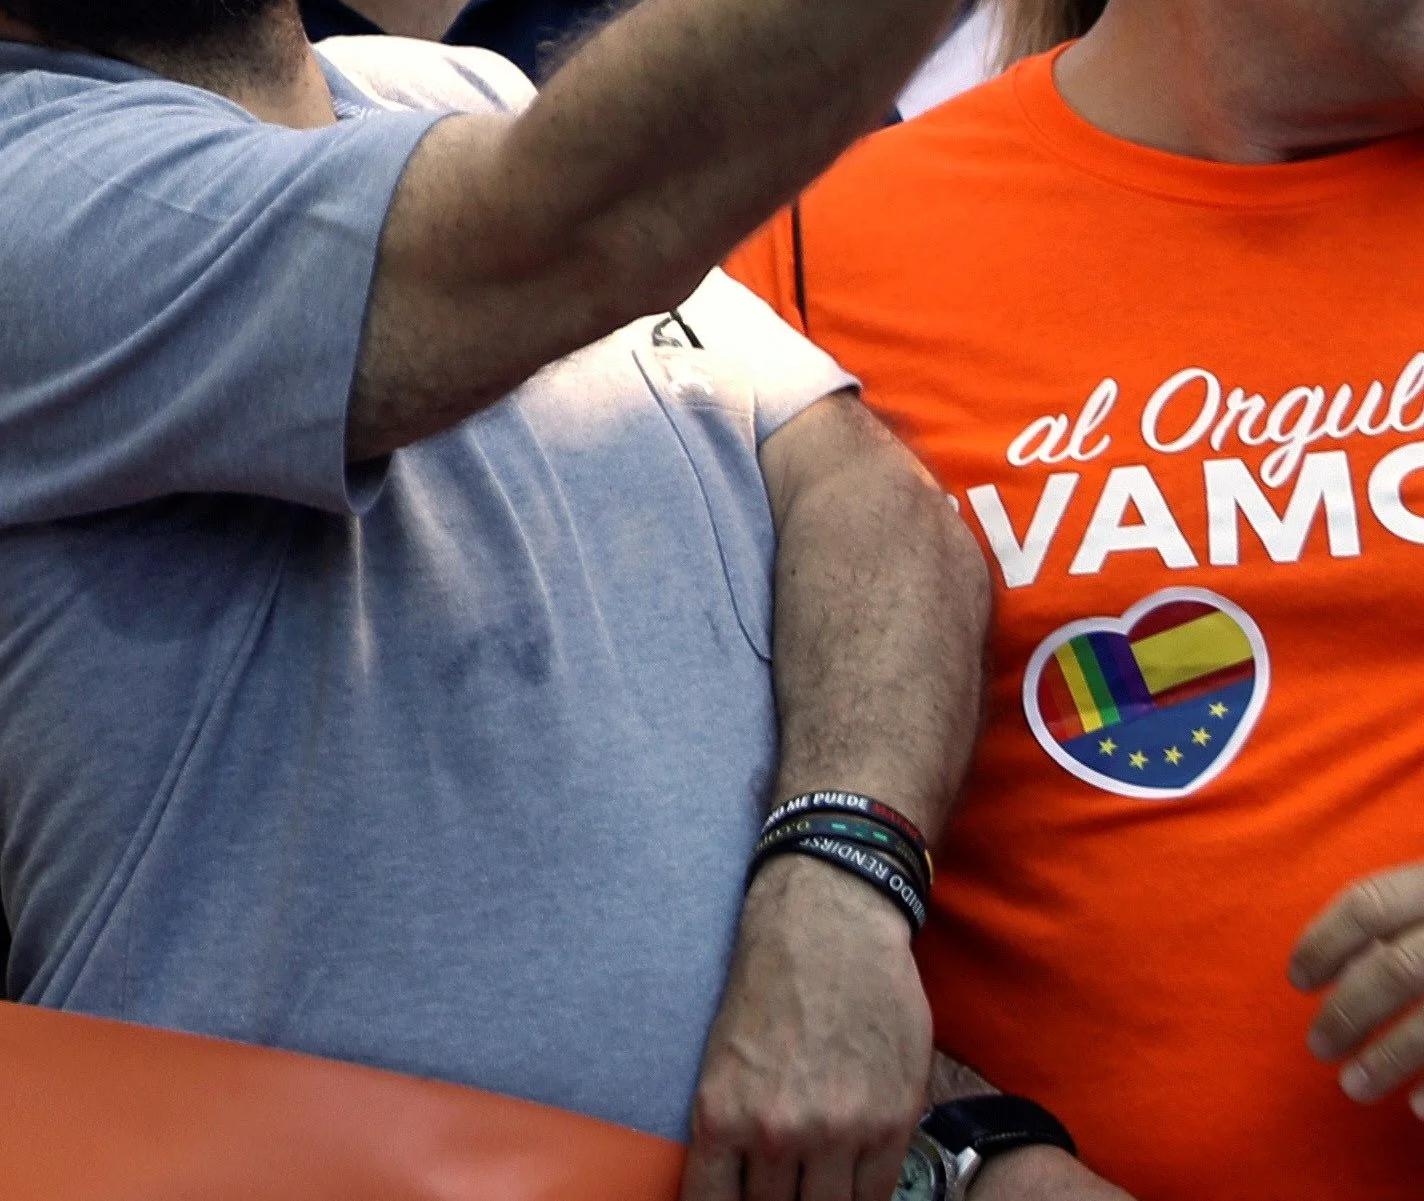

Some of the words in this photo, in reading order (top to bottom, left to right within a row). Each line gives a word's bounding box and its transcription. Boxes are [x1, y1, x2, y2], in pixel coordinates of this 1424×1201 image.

[1006, 376, 1119, 467] al
[949, 440, 1424, 589] VAMO
[812, 791, 870, 811] PUEDE
